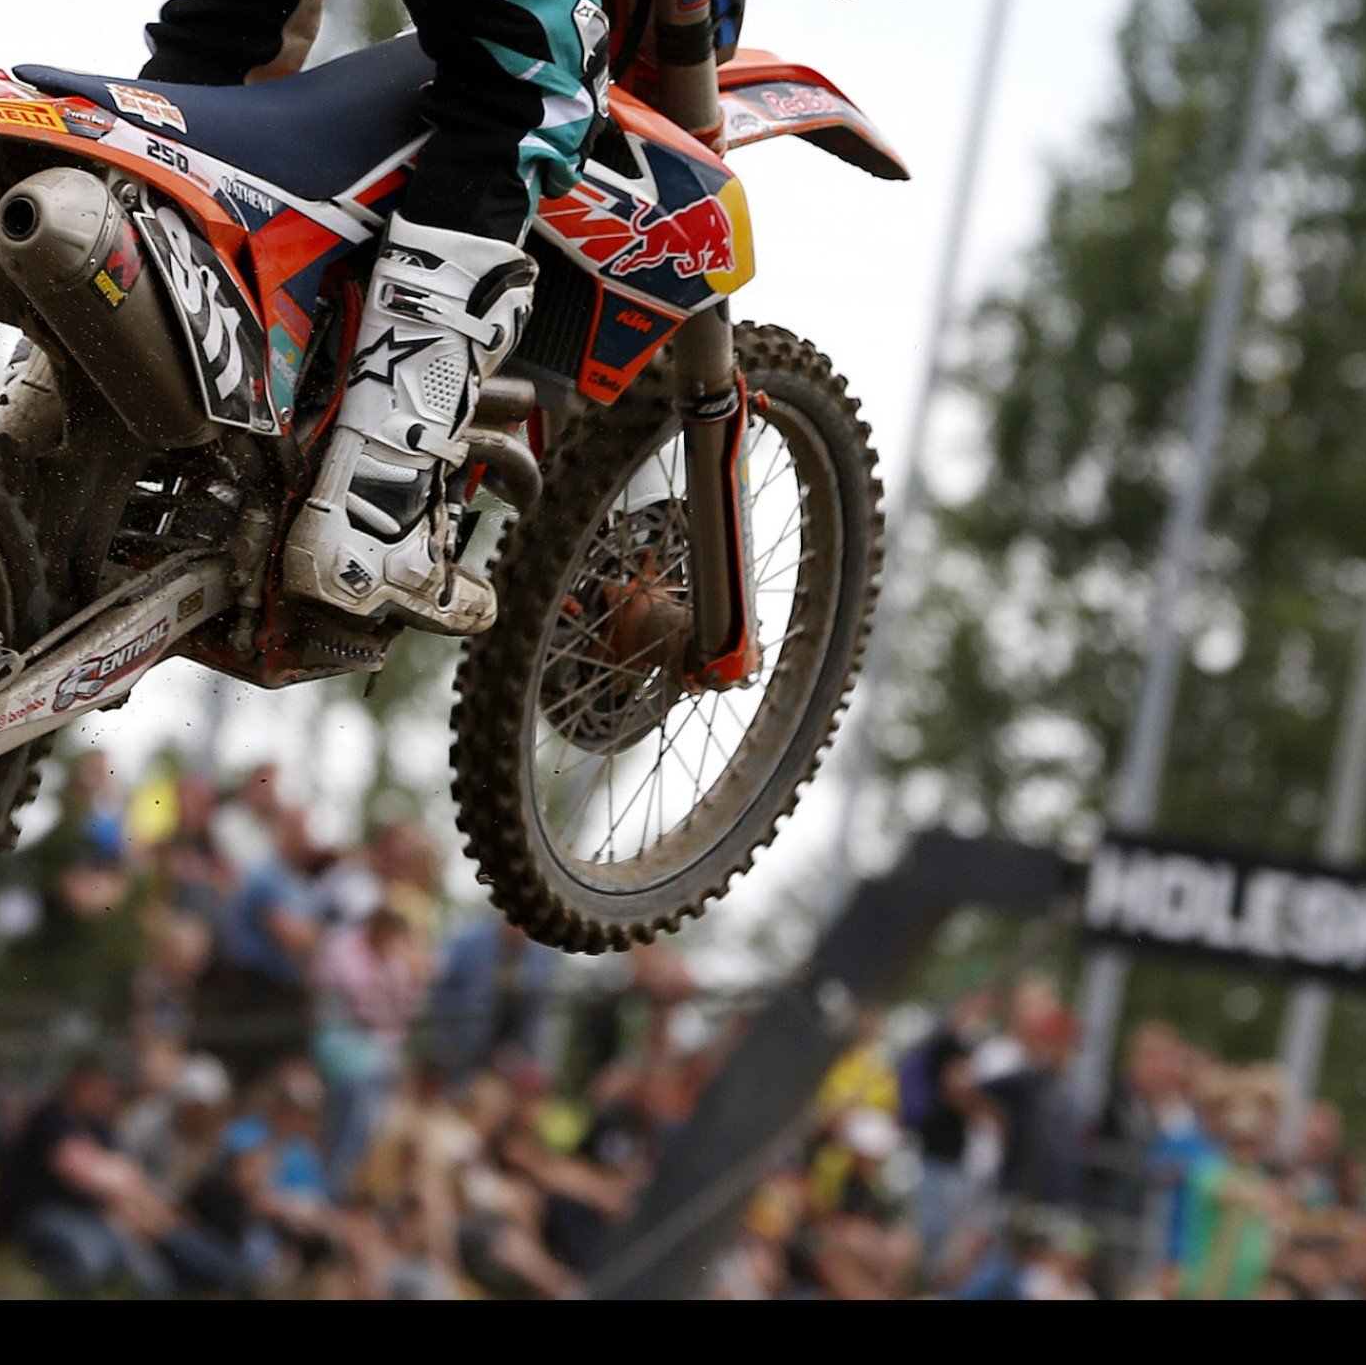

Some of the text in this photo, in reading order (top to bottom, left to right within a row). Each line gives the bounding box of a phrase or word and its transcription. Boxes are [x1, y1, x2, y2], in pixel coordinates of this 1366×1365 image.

[146, 137, 189, 174] 250
[231, 180, 274, 217] ATHENA
[155, 206, 243, 400] 911
[614, 309, 655, 334] KTM
